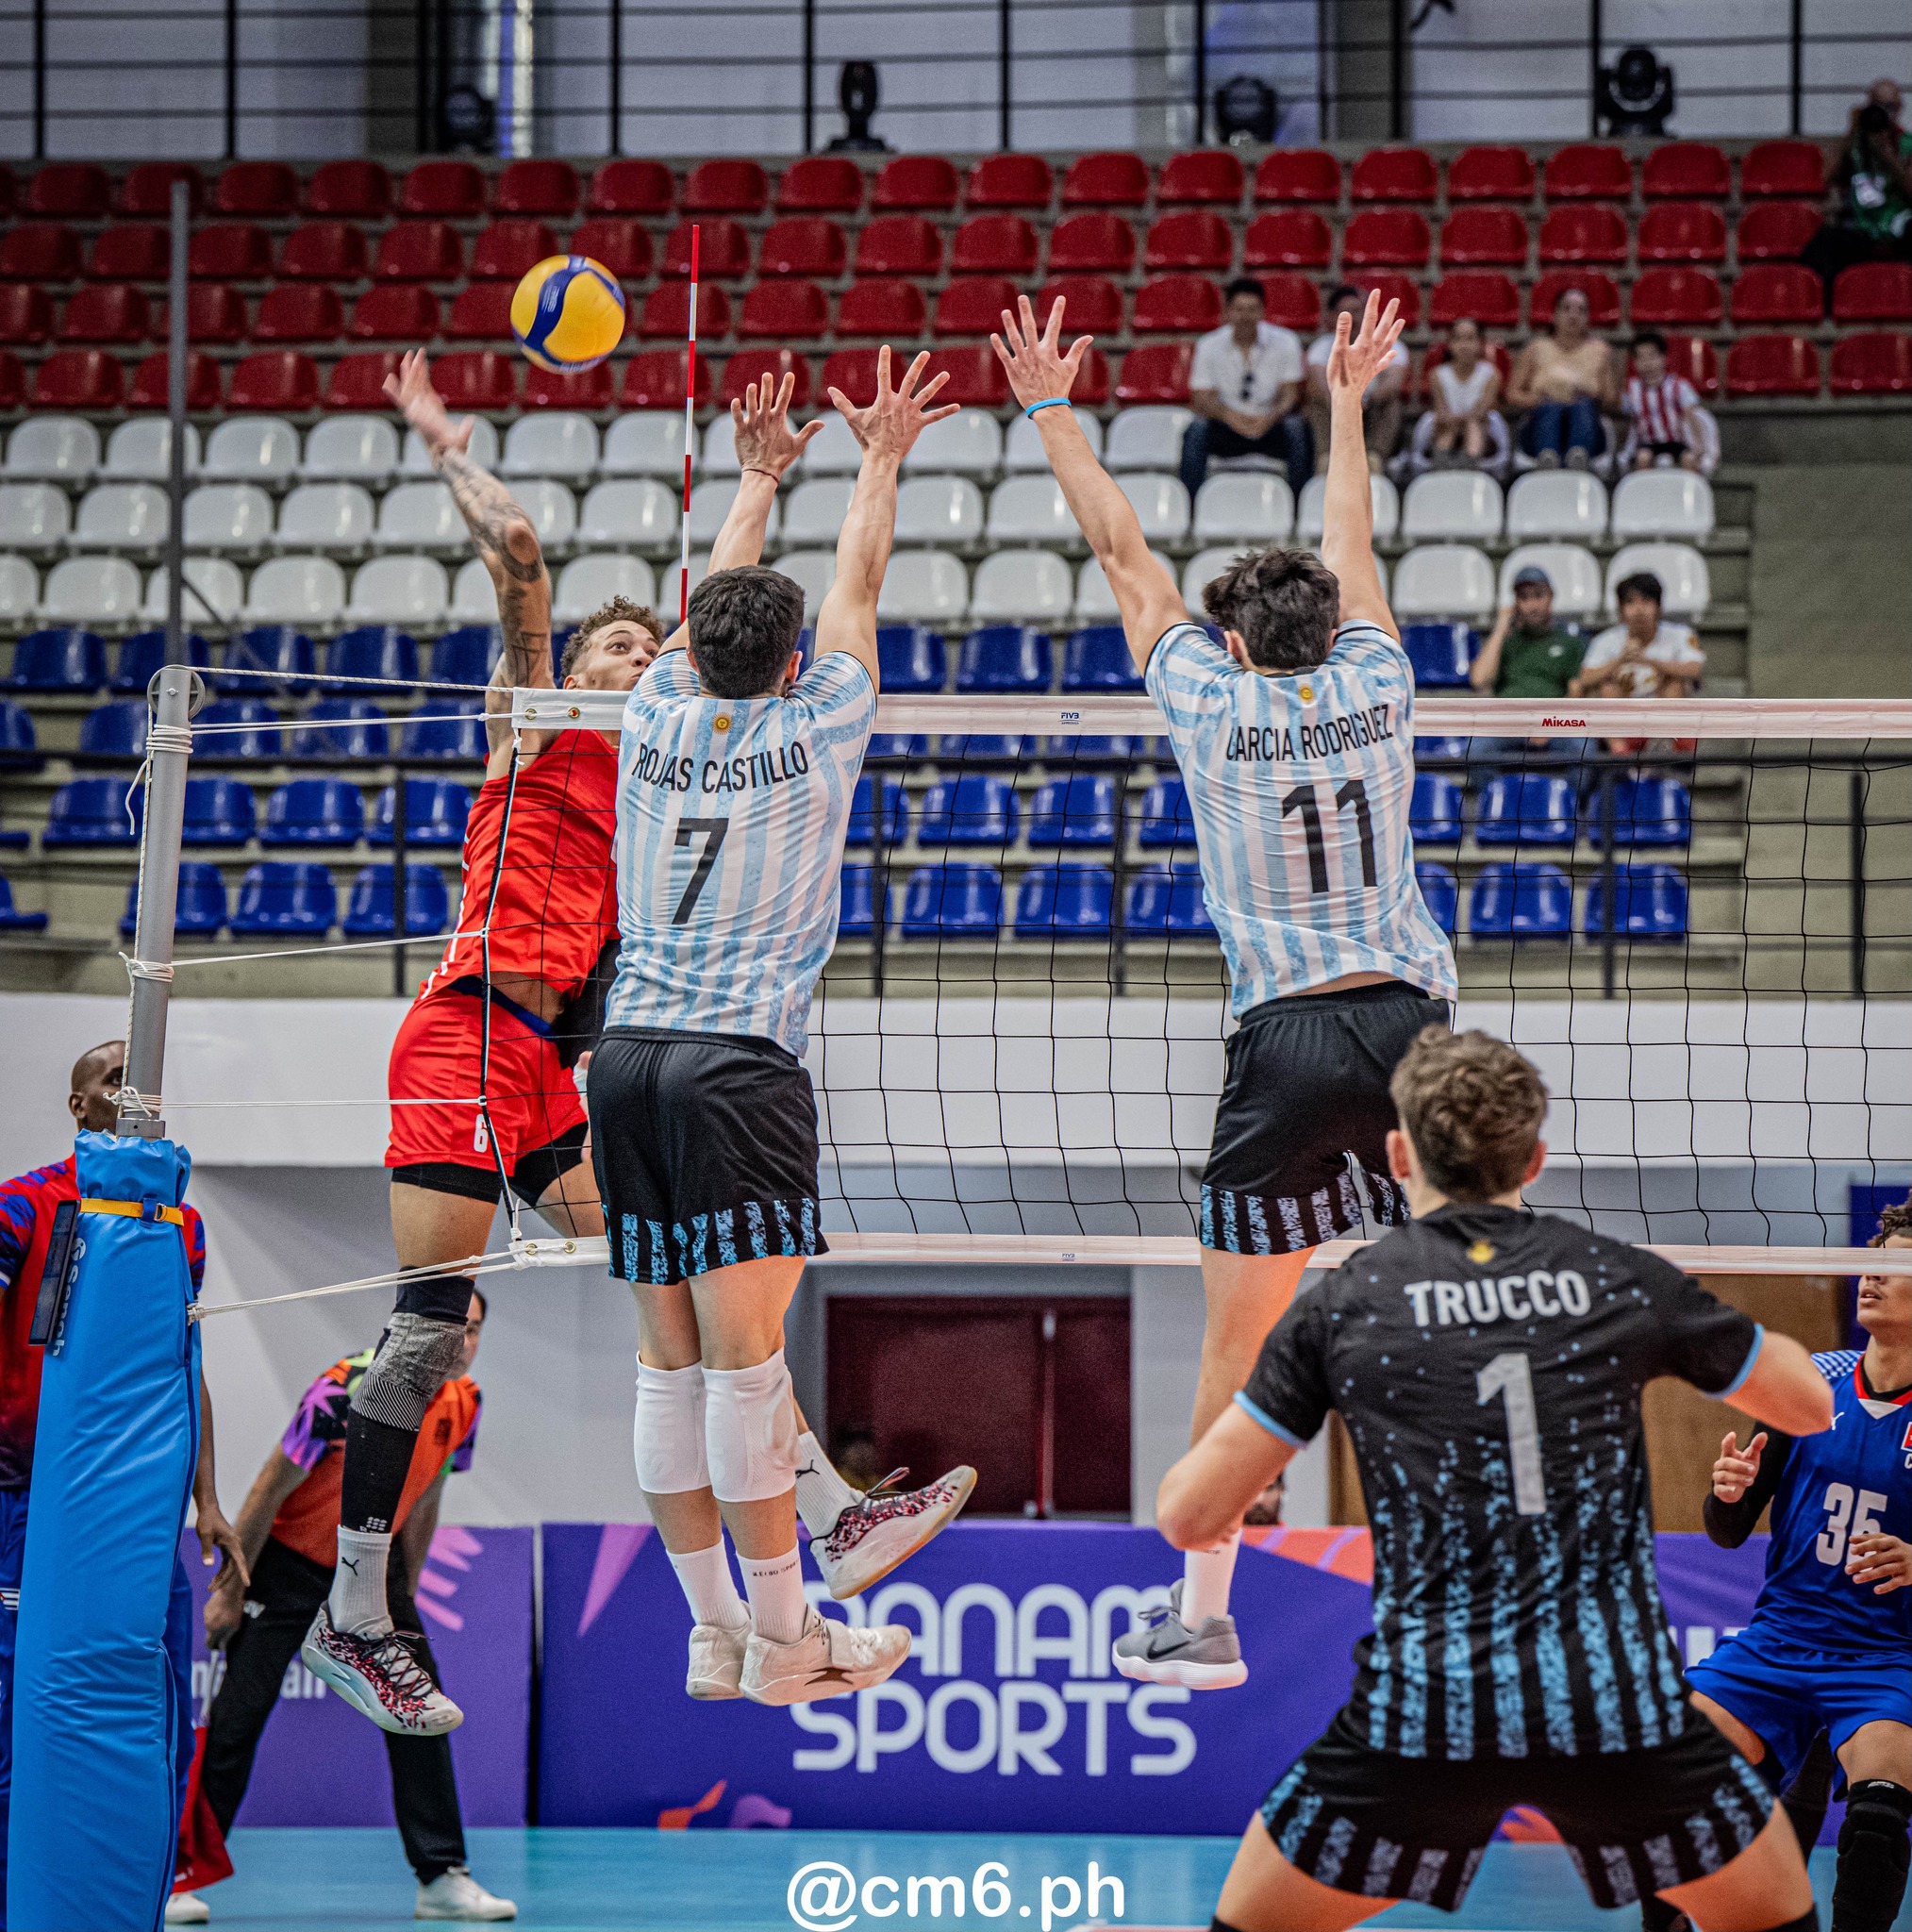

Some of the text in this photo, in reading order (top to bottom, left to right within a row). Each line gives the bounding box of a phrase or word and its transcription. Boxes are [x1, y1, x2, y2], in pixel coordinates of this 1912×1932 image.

[632, 741, 808, 793] ROJAS CASTILLO
[1301, 704, 1393, 759] RODRIGUEZ
[672, 817, 729, 925] 7
[1282, 779, 1377, 893] 11
[474, 1113, 489, 1153] 6
[1404, 1270, 1590, 1326] TRUCCO
[1476, 1353, 1546, 1515] 1
[1816, 1482, 1888, 1573] 35
[789, 1679, 1197, 1776] SPORTS
